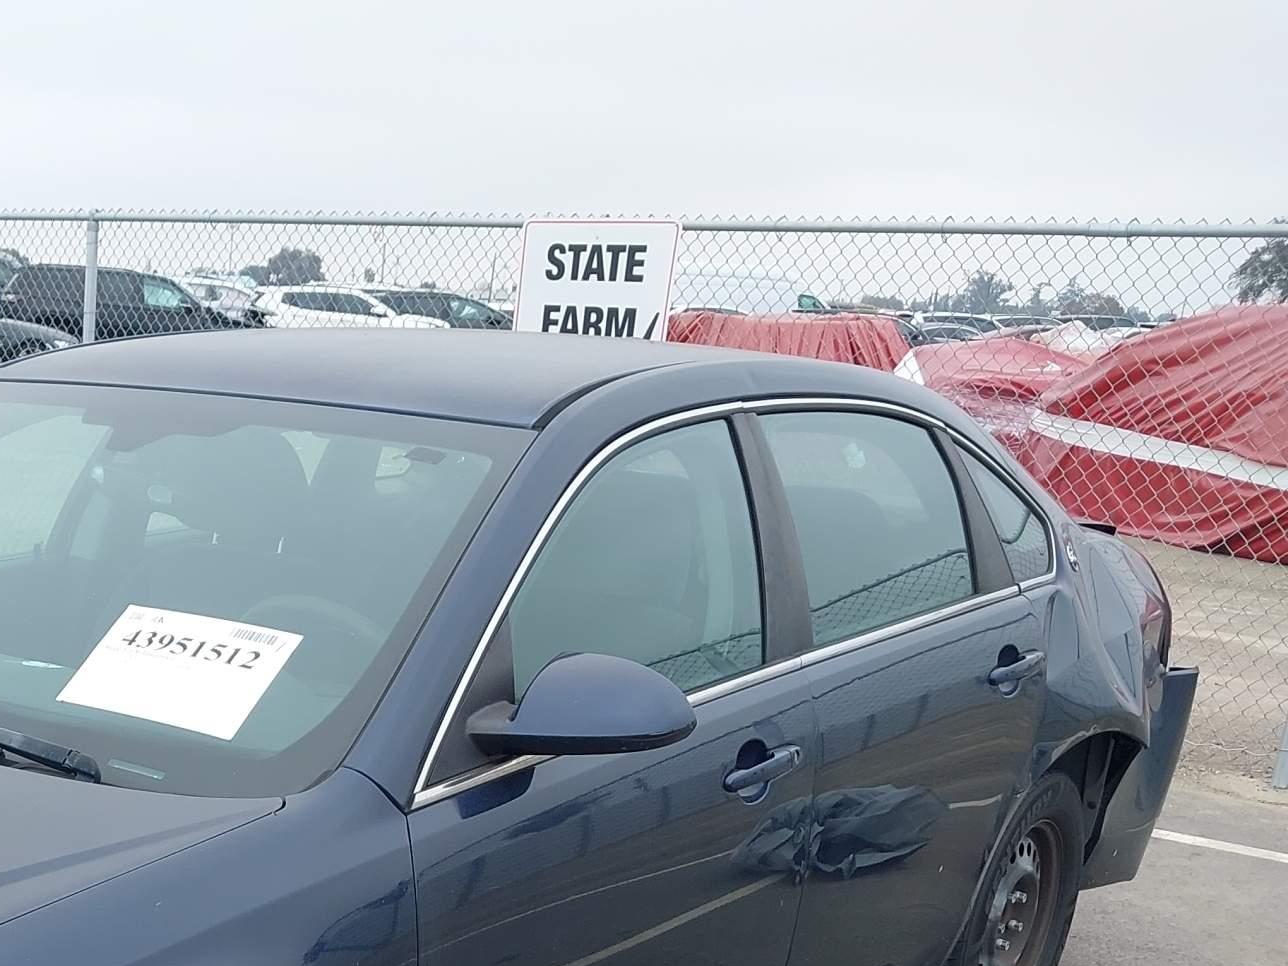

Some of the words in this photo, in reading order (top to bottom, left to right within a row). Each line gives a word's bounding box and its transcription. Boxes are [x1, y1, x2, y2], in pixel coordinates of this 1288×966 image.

[545, 243, 647, 283] STATE
[541, 304, 637, 339] FARM
[121, 629, 262, 670] 43951512
